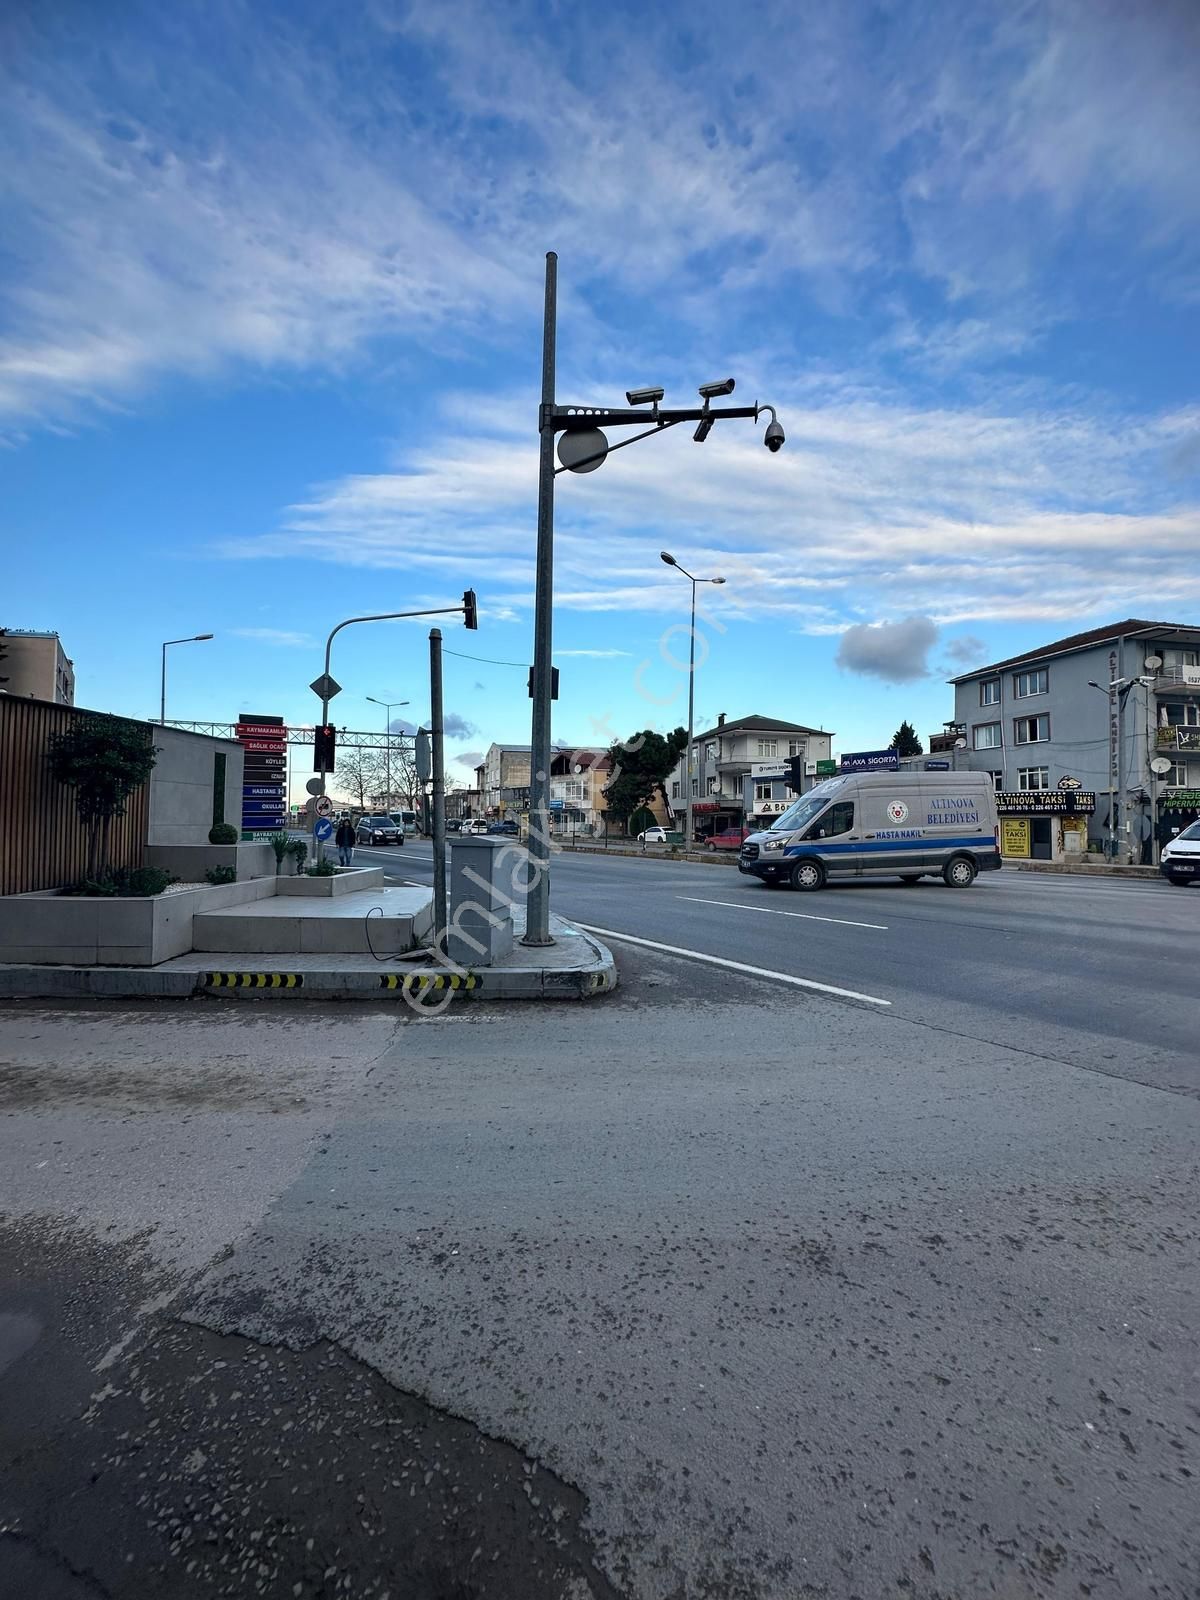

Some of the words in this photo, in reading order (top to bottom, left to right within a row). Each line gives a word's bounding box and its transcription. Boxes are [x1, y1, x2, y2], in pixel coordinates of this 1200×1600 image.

[249, 742, 268, 750] SAĞLIK
[868, 755, 897, 765] SİGORTA
[930, 798, 975, 810] ALTINOVA
[995, 796, 1036, 805] ALTINOVA
[927, 810, 979, 825] BELEDİYESİ
[876, 830, 899, 840] HASTA
